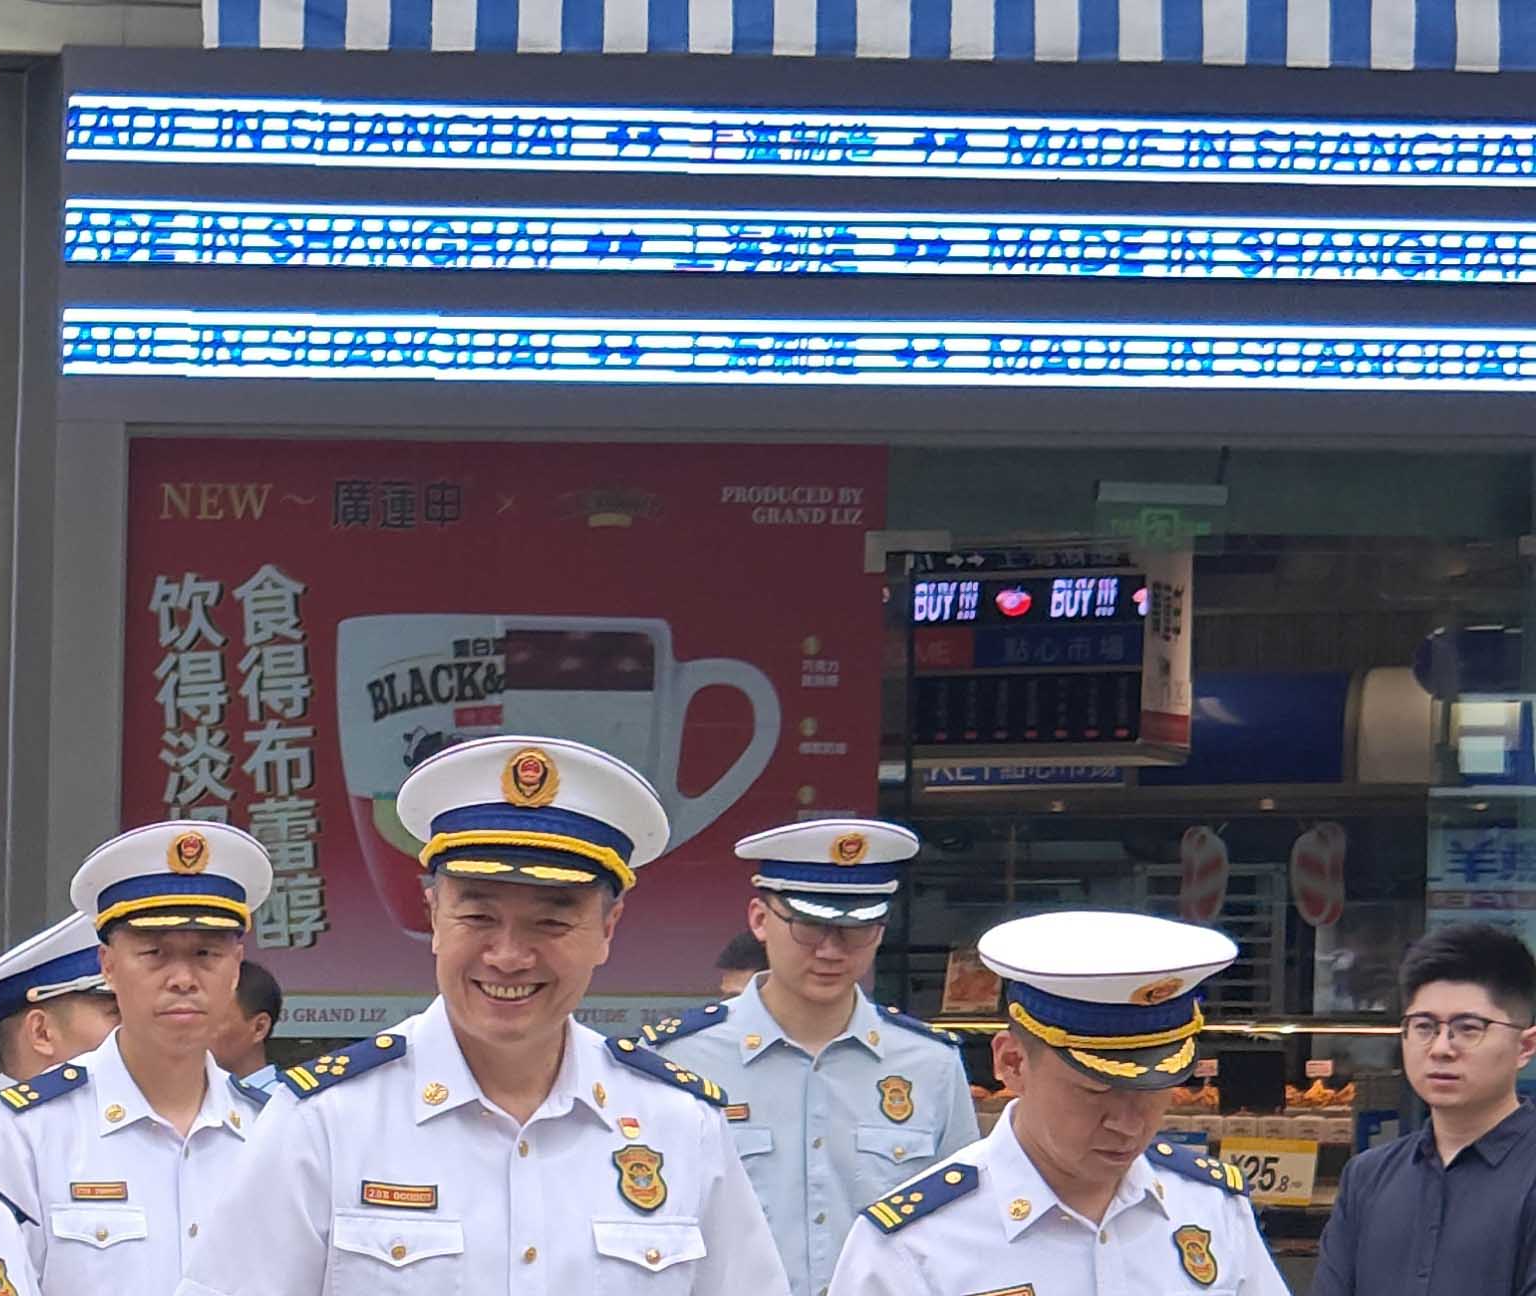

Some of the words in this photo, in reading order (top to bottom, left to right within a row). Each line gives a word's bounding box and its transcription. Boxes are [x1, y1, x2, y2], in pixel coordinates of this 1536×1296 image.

[217, 109, 265, 155] IN
[289, 110, 573, 160] SHANGHAI
[1007, 126, 1163, 171] MADE
[1184, 128, 1232, 173] IN
[195, 210, 243, 266] IN
[269, 213, 553, 271] SHANGHAI
[988, 226, 1145, 275] MADE
[1165, 228, 1213, 277] IN
[1238, 230, 1522, 282] SHANGHAI
[195, 325, 243, 366] IN
[268, 327, 553, 372] SHANGHAI
[988, 335, 1145, 377] MADE
[1165, 338, 1213, 380] IN
[1237, 339, 1522, 385] SHANGHAI
[159, 481, 275, 521] NEW
[720, 485, 833, 504] PRODUCED
[836, 486, 865, 504] BY
[751, 507, 827, 525] GRAND
[831, 508, 863, 525] LIZ
[148, 571, 235, 823] 饮得淡
[292, 1007, 356, 1023] GRAND
[359, 1007, 387, 1023] LIZ
